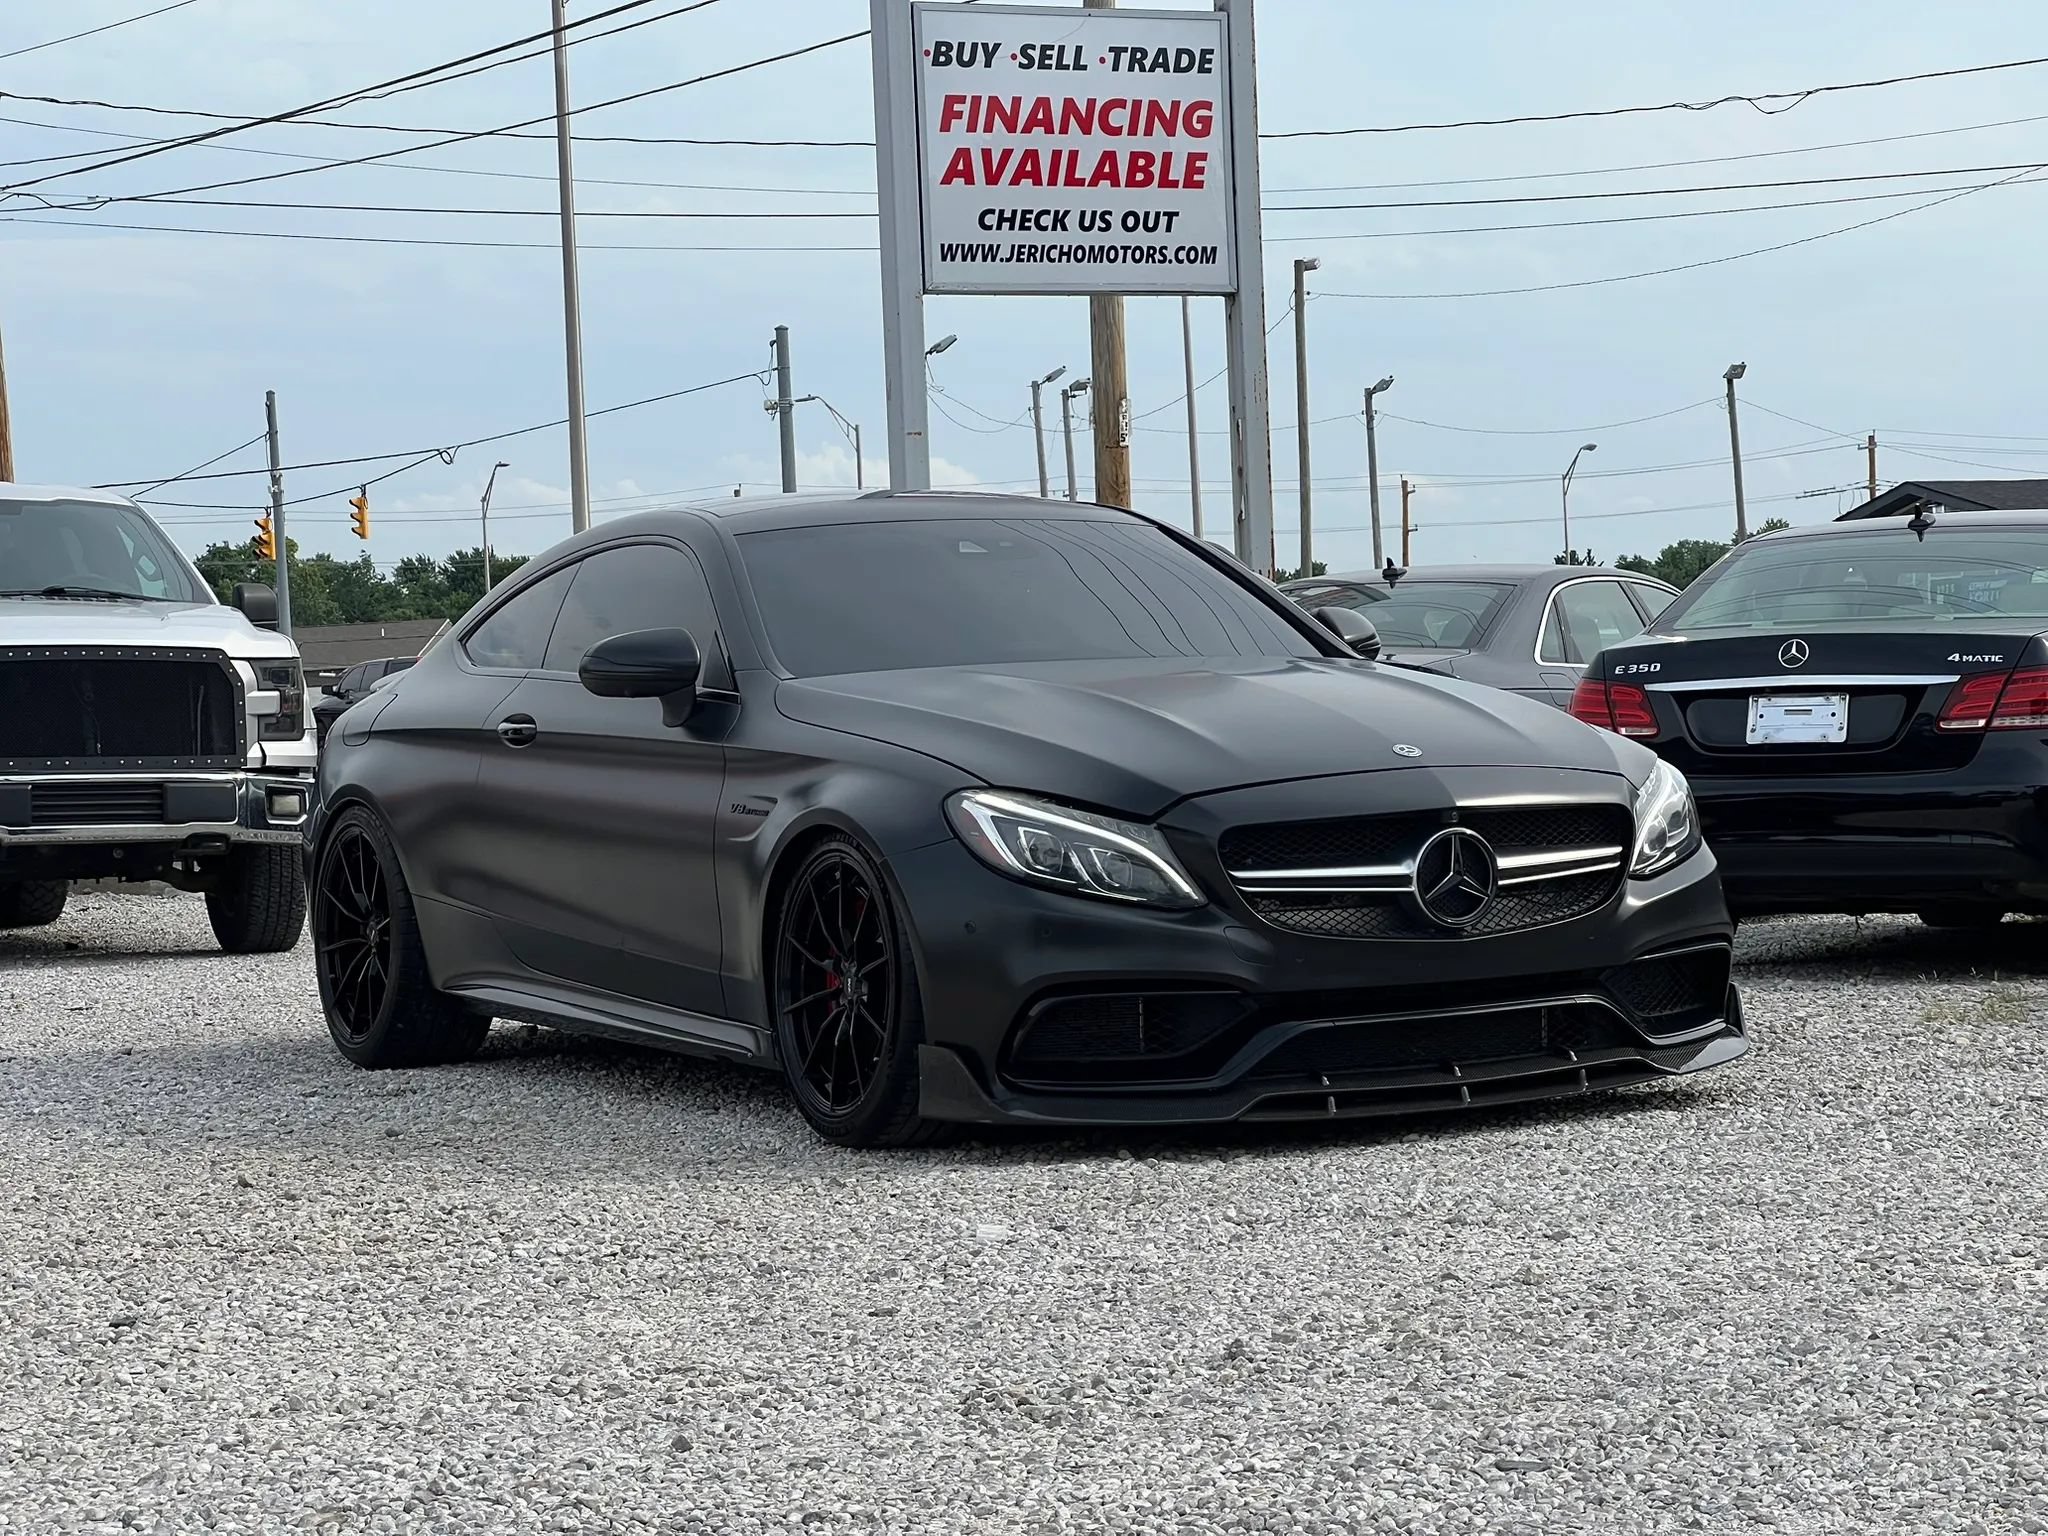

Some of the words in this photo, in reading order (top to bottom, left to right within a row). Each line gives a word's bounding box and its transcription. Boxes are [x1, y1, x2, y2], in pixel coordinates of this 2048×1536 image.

[931, 40, 1002, 69] BUY
[1017, 43, 1089, 71] SELL
[1107, 46, 1215, 75] TRADE
[938, 94, 1214, 138] FINANCING
[939, 147, 1209, 190] AVAILABLE
[977, 208, 1071, 232] CHECK
[1077, 209, 1114, 233] US
[1120, 210, 1180, 233] OUT
[939, 243, 1218, 265] WWW.JERICHOMOTORS.COM
[1614, 665, 1626, 675] E
[1627, 663, 1661, 674] 350
